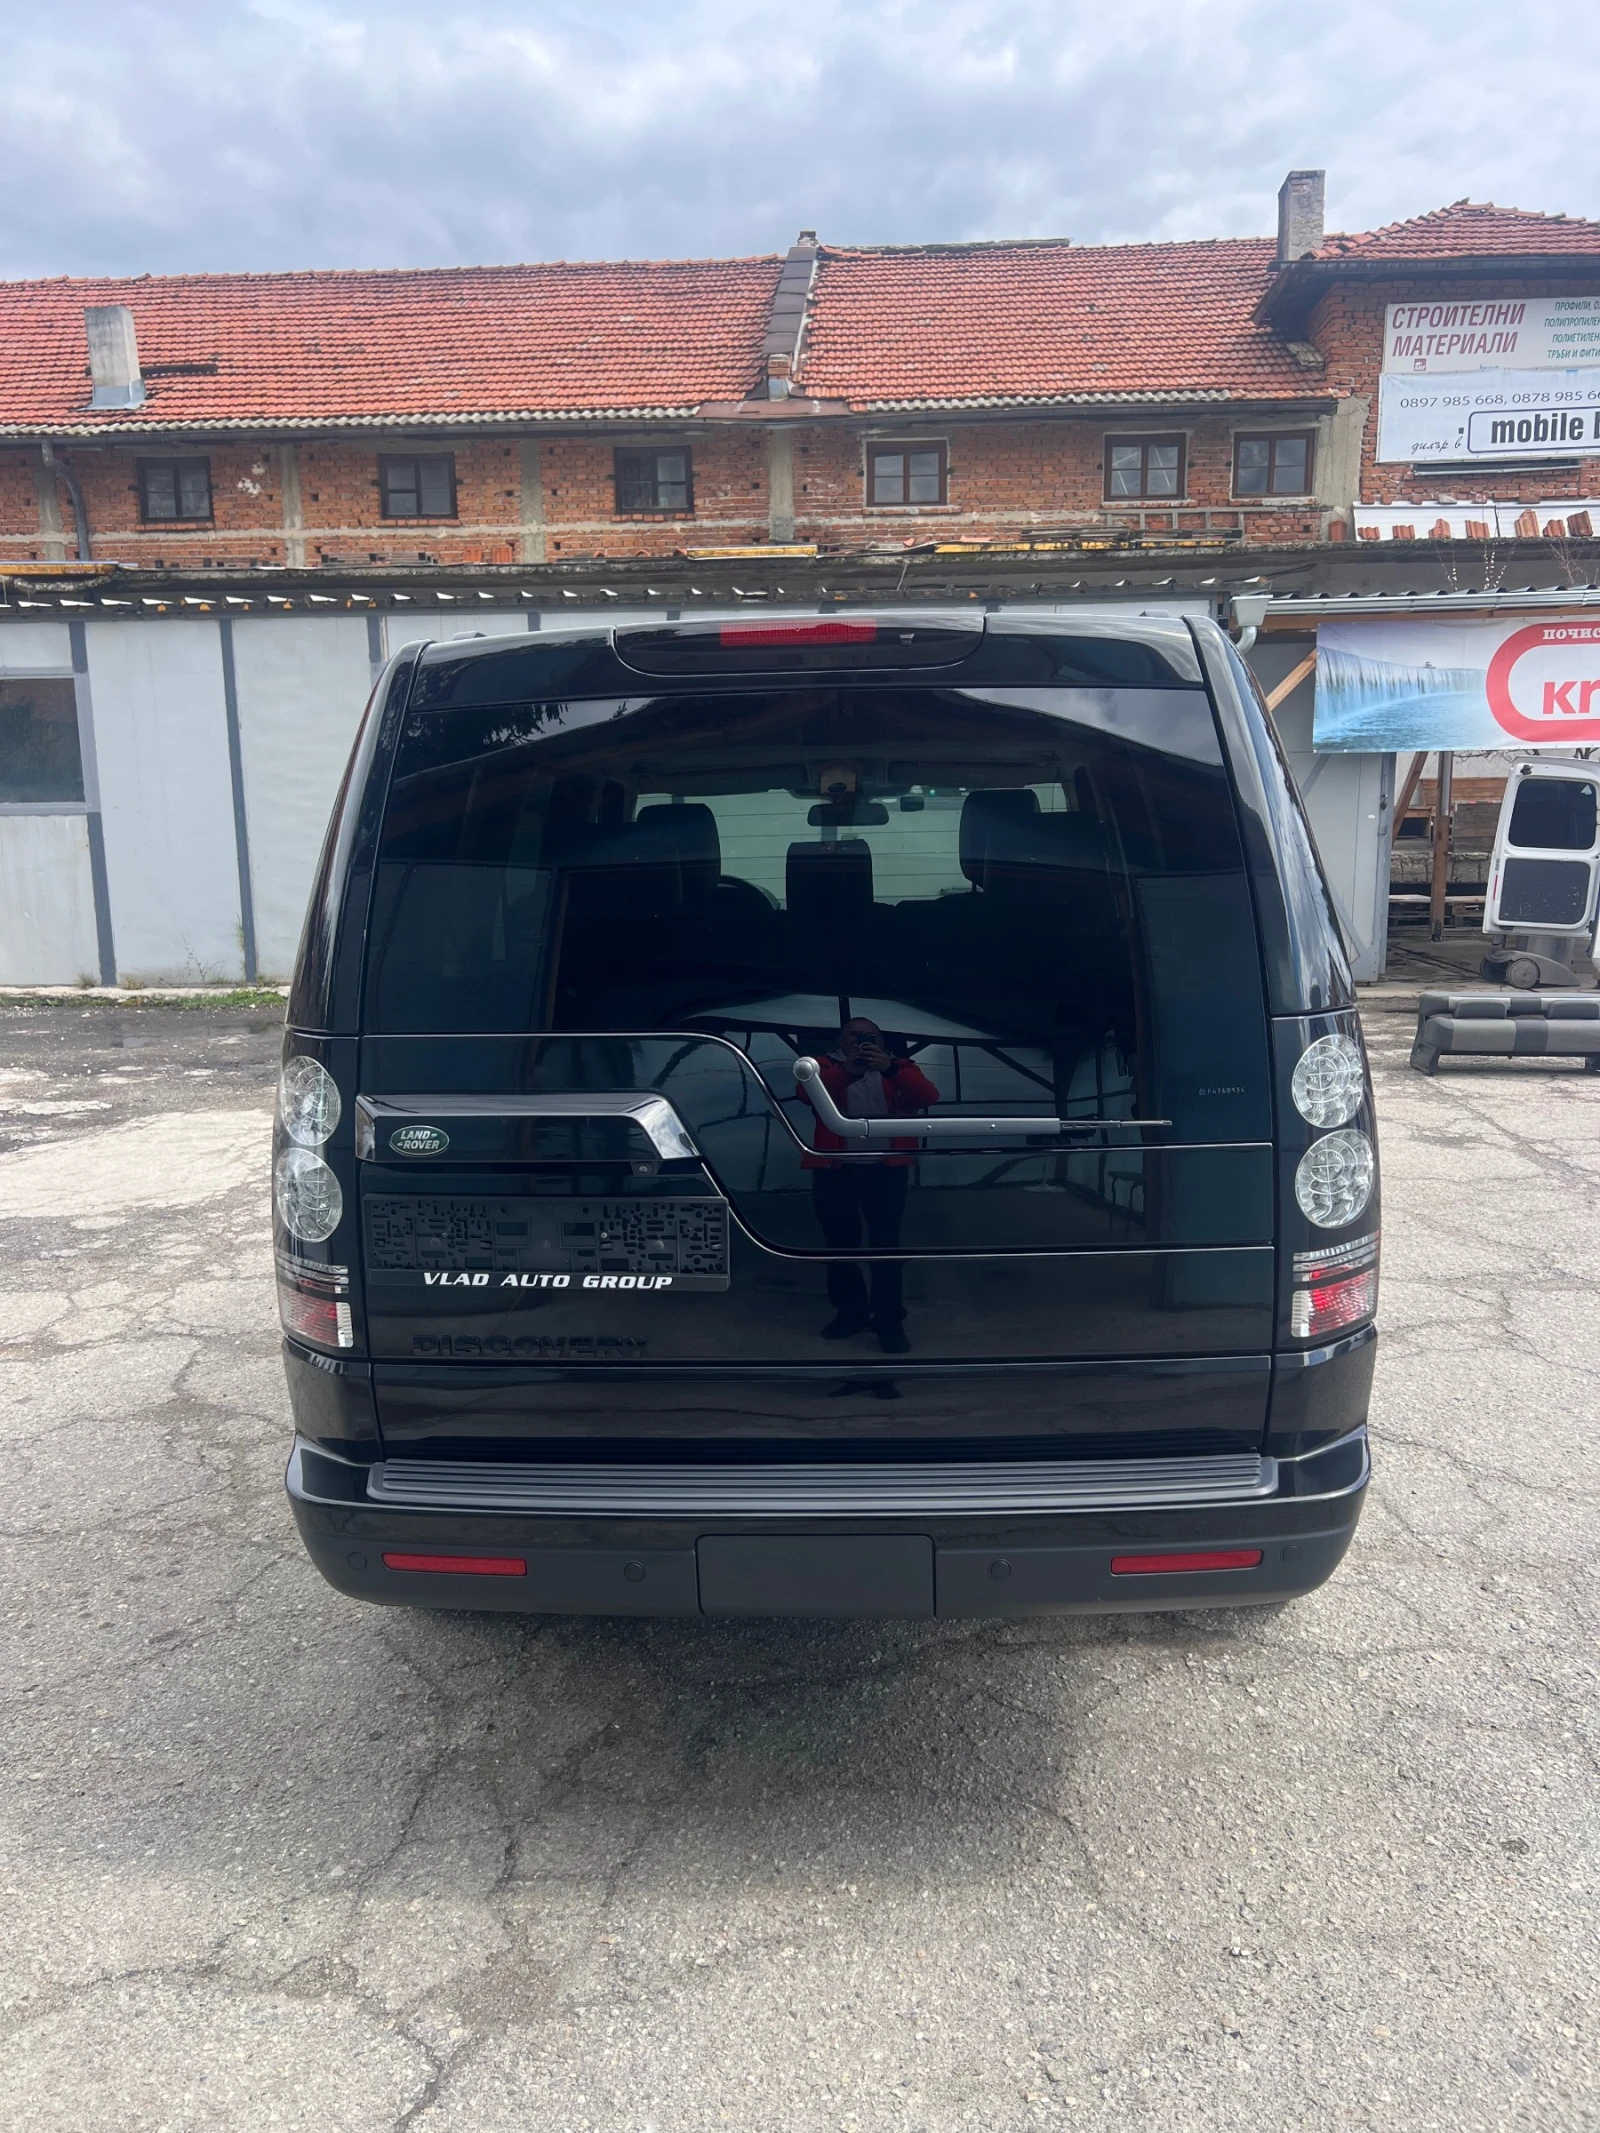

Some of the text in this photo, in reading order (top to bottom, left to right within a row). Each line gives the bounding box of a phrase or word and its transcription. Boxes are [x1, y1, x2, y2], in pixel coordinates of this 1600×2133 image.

[1392, 303, 1526, 329] СТРОИТЕЛНИ
[1392, 332, 1518, 357] МАТЕРИАЛИ
[1547, 349, 1571, 359] ТРЪБИ
[1572, 349, 1578, 358] И
[1400, 390, 1600, 408] 0897 985 668, 0878 985 6
[1491, 412, 1584, 444] mobile
[400, 1130, 431, 1140] LAND
[403, 1140, 440, 1149] ROVER
[423, 1272, 673, 1289] VLAD AUTO GROUP
[413, 1334, 648, 1357] DISCOVERY
